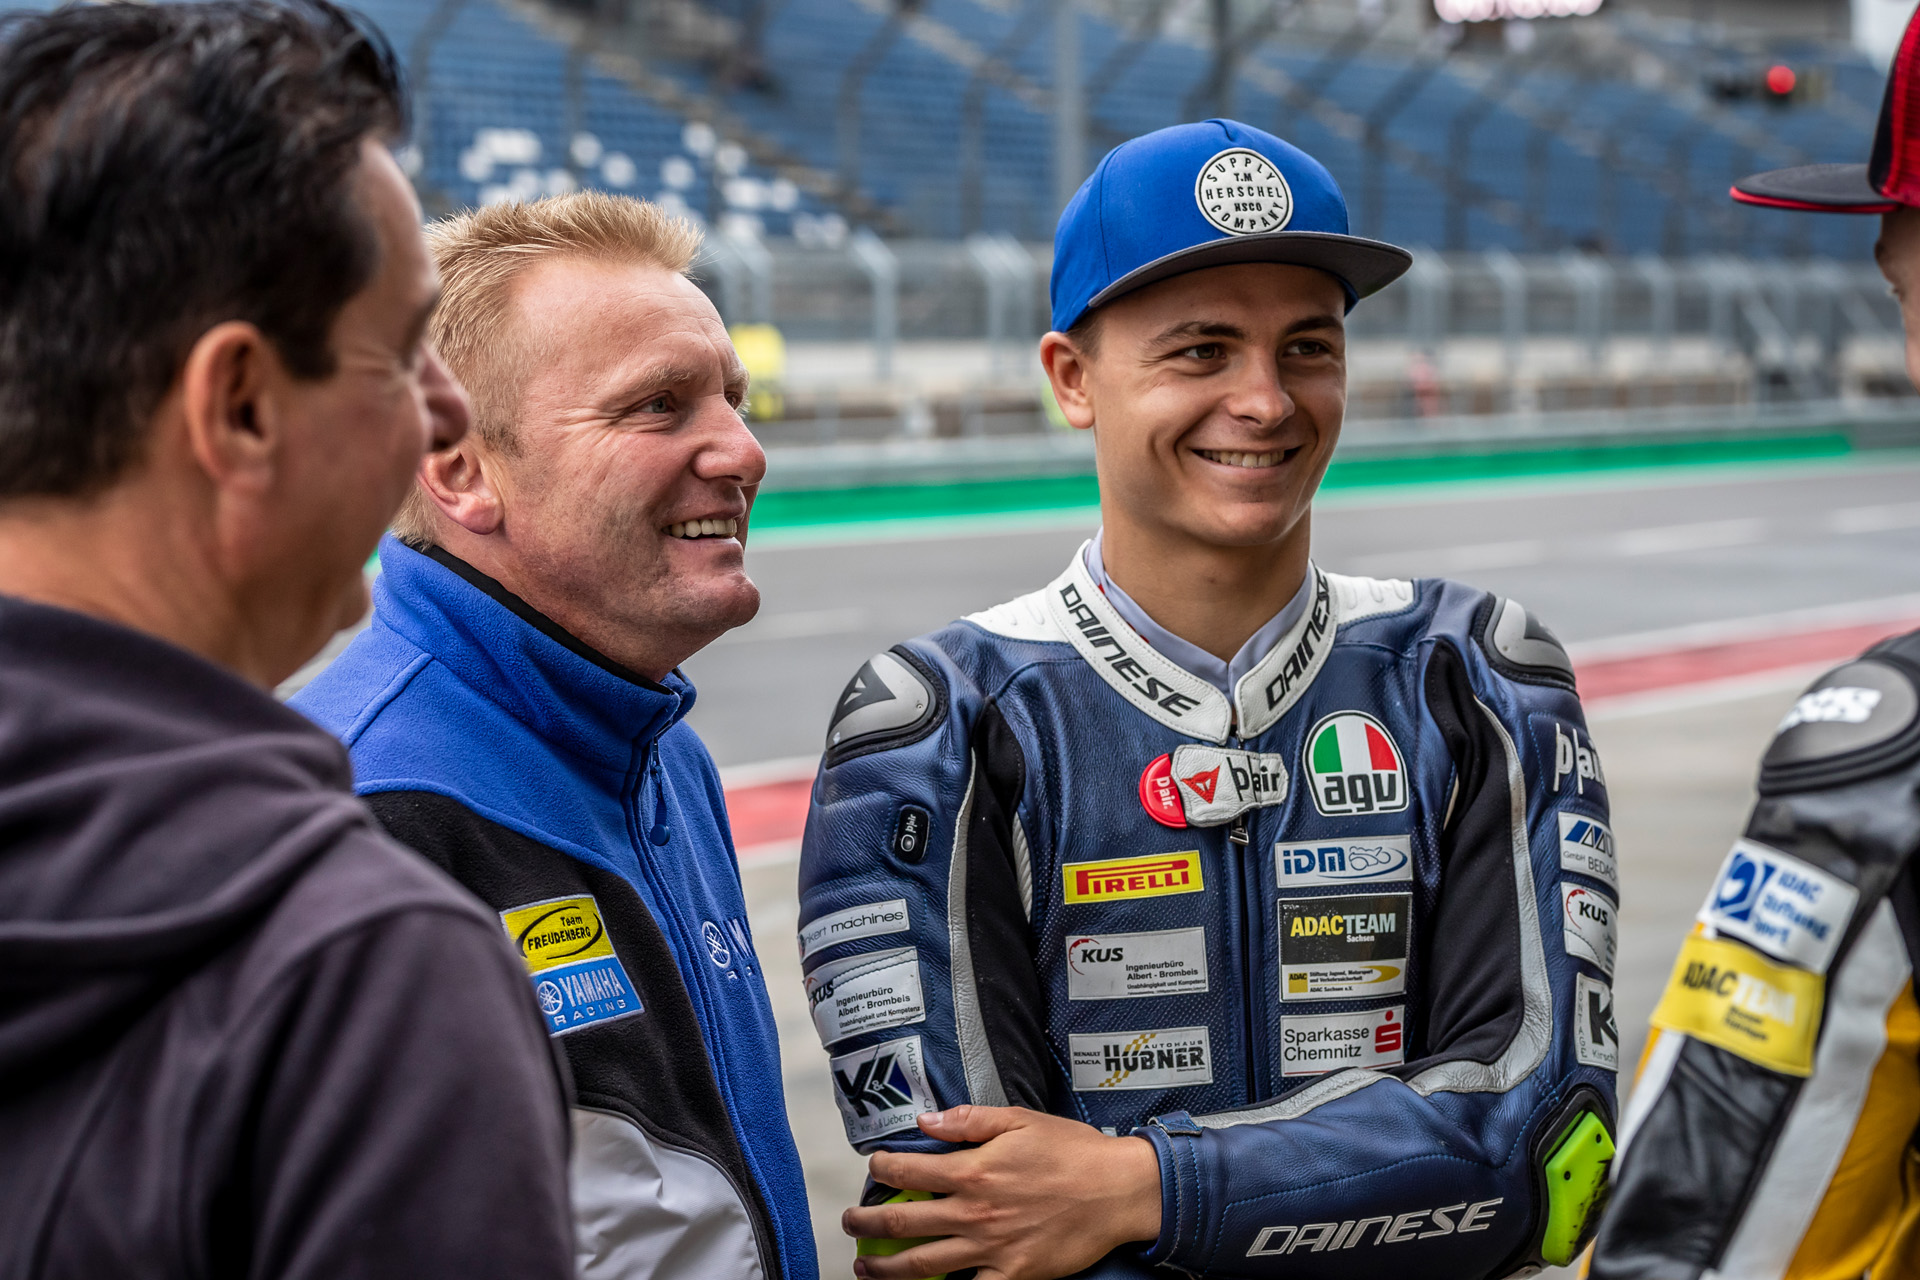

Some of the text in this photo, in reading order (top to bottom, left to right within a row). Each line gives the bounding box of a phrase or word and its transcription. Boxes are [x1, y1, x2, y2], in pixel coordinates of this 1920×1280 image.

[1206, 157, 1276, 183] SUPPLY
[1205, 186, 1283, 200] HERSCHEL
[1211, 201, 1284, 230] COMPANY
[1234, 202, 1262, 212] HSCO
[1060, 582, 1202, 717] DAINESE
[1323, 772, 1398, 813] agv
[1075, 859, 1190, 896] PIRELLI
[560, 915, 584, 928] Team
[831, 911, 905, 933] machines
[1579, 900, 1609, 927] KUS
[527, 925, 592, 951] FREUDENBERG
[1346, 934, 1375, 943] Sachsen
[1081, 947, 1124, 964] KUS
[1126, 961, 1184, 972] Ingenieurbüro
[1127, 972, 1153, 981] Albert
[1159, 968, 1199, 979] Brombeis
[1289, 973, 1308, 981] ADAC
[558, 966, 626, 1008] YAMAHA
[836, 986, 894, 1008] Ingenieurbüro
[553, 998, 627, 1026] RACING
[838, 1004, 860, 1019] Albert
[867, 994, 911, 1010] Brombeis
[876, 1010, 887, 1019] und
[888, 1006, 921, 1017] Kompetenz
[1144, 1039, 1204, 1050] AUTOHAUS
[1284, 1027, 1370, 1046] Sparkasse
[1283, 1044, 1362, 1062] Chemnitz
[906, 1042, 933, 1113] SERVIC
[1245, 1197, 1505, 1257] DAINESE
